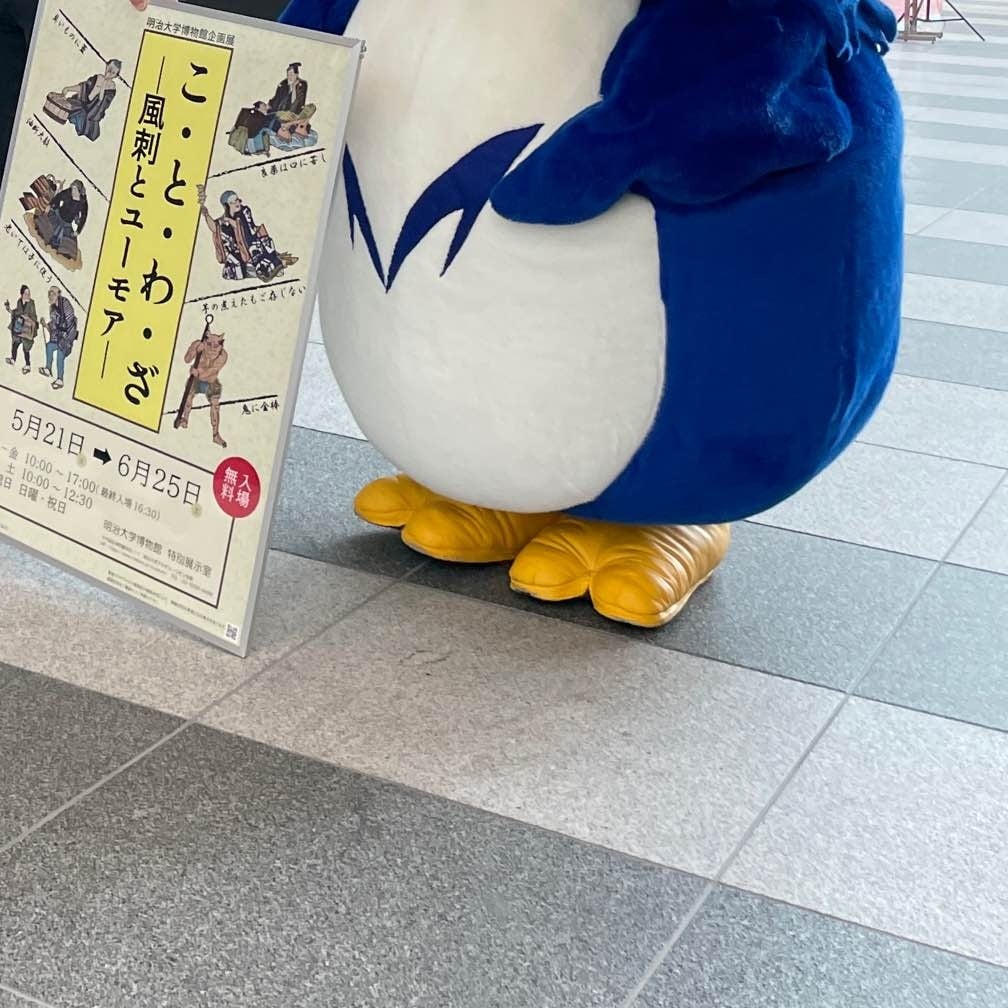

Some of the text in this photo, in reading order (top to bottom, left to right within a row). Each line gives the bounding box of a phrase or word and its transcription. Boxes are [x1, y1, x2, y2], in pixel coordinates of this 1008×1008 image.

[145, 16, 236, 47] 明治大学博物館企画展
[11, 408, 85, 457] 5月21日
[5, 462, 16, 476] 土
[117, 453, 201, 506] 6月25日
[103, 519, 163, 555] 明治大学博物館
[167, 548, 213, 578] 特別展示室
